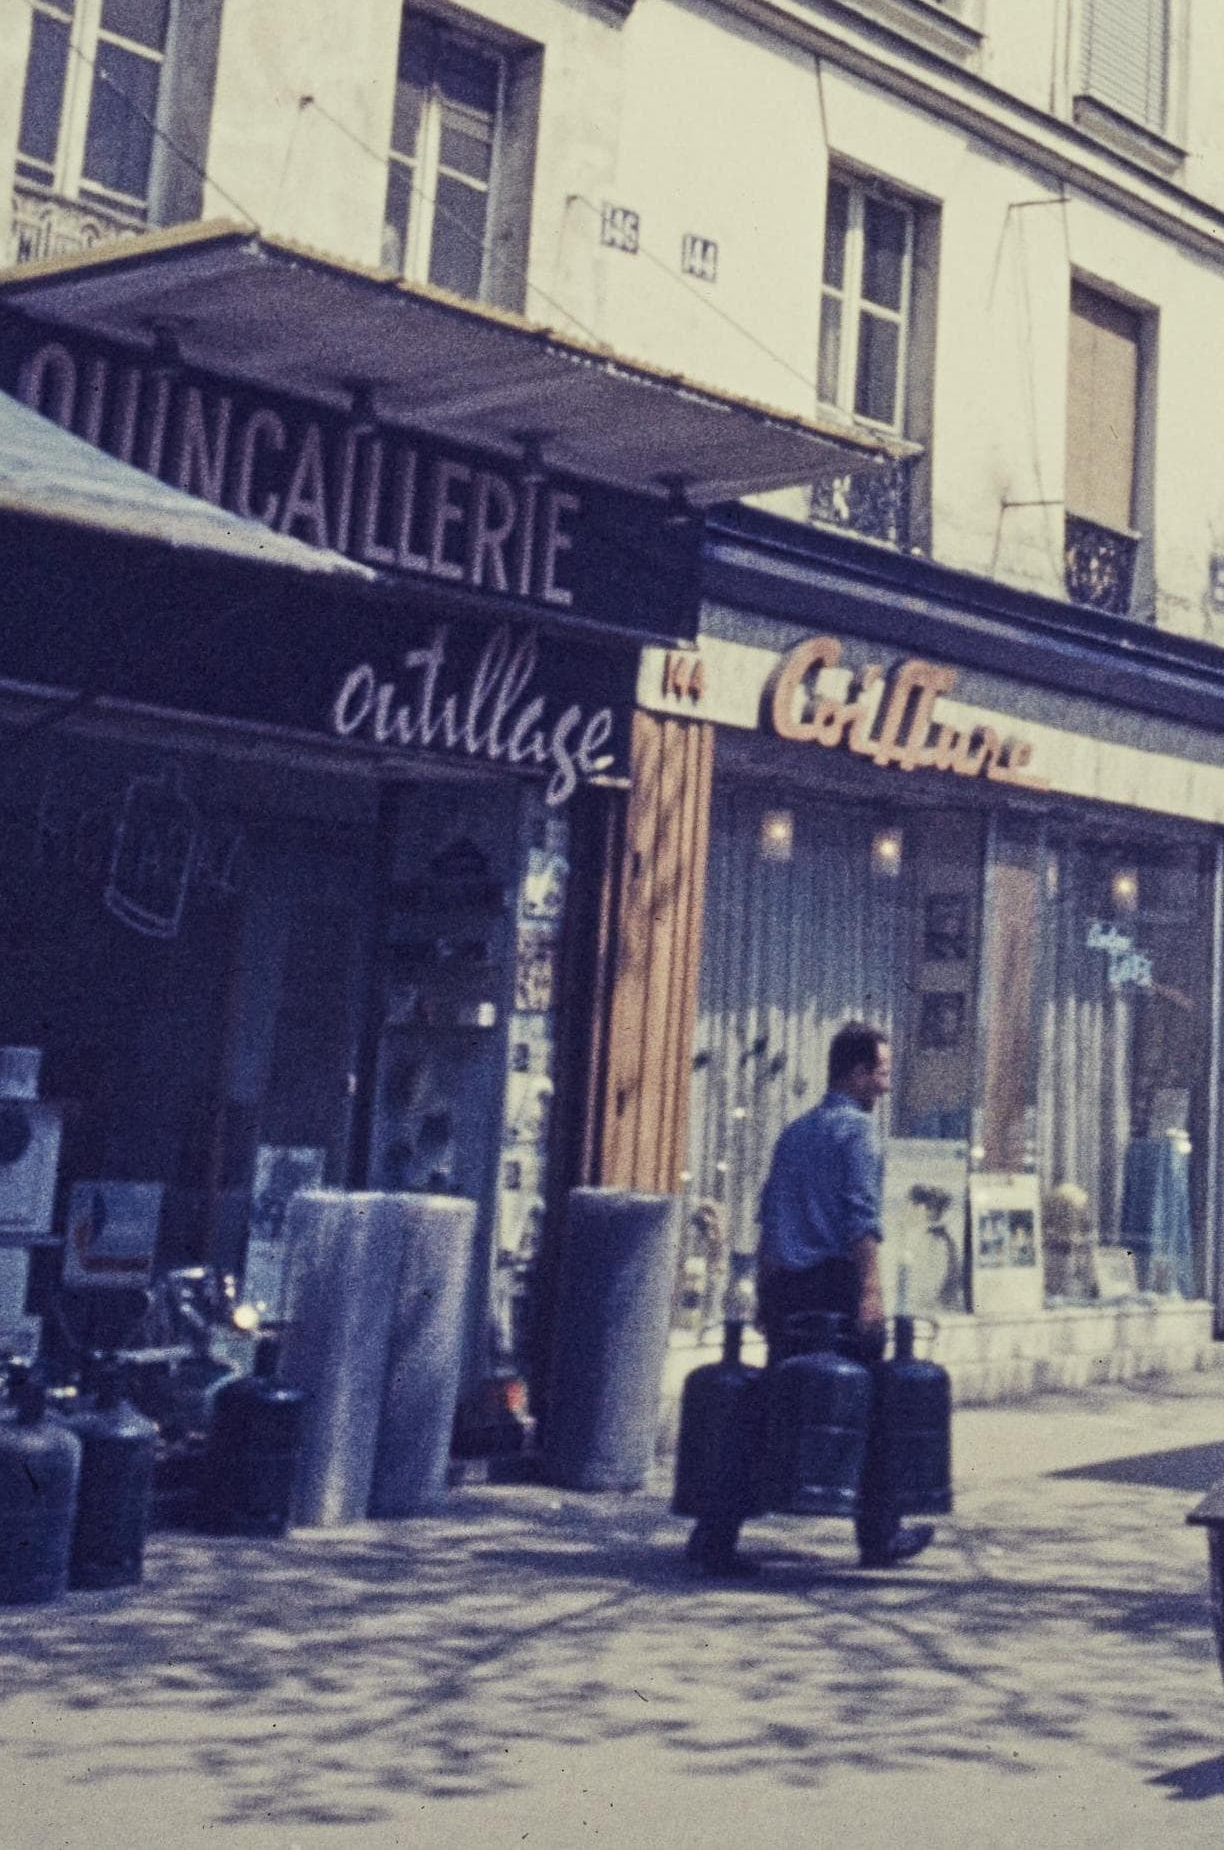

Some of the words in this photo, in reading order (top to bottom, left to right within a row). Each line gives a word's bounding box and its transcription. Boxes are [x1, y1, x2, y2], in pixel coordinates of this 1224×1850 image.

[20, 343, 580, 606] QUINCAILLERIE
[334, 625, 614, 805] outillage
[662, 651, 704, 705] 144
[772, 635, 1051, 792] Coiffure
